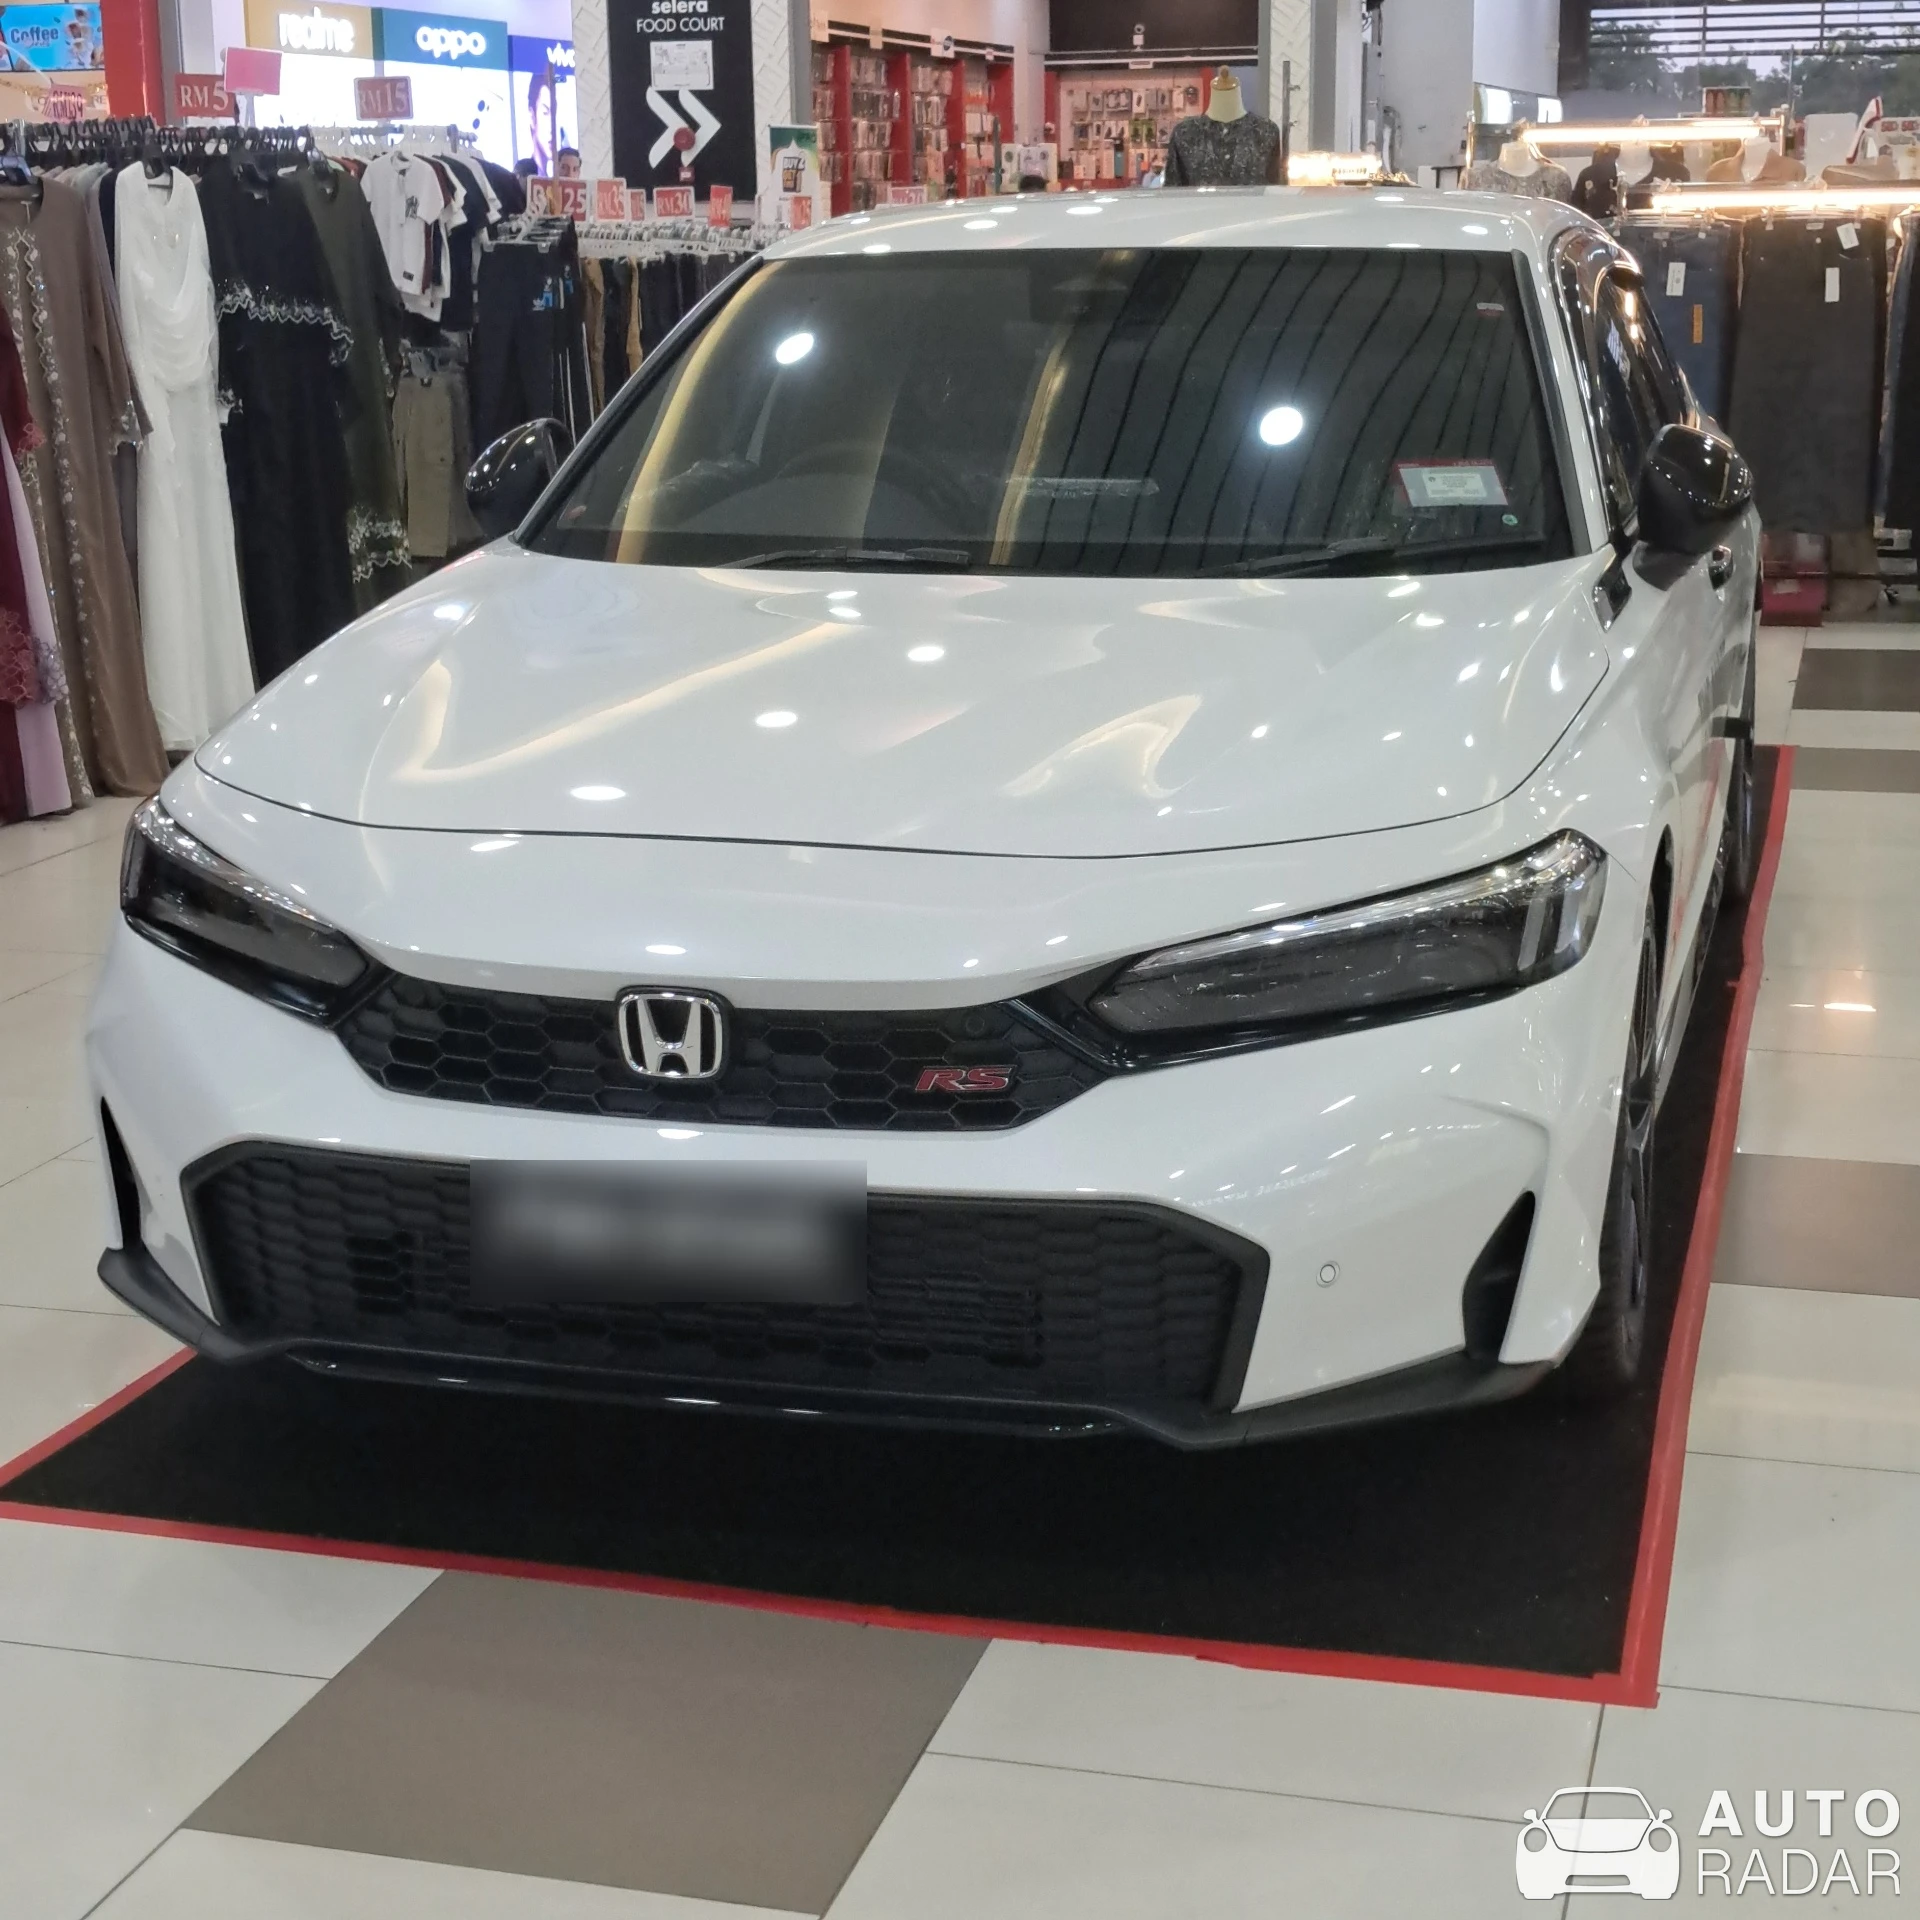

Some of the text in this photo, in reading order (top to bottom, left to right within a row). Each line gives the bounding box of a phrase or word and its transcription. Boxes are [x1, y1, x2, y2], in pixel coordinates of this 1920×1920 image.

[651, 0, 709, 14] selera
[10, 27, 59, 43] Coffee
[278, 6, 355, 52] realme
[636, 17, 725, 33] FOOD COURT
[416, 26, 486, 60] oppo
[915, 1066, 1015, 1091] RS
